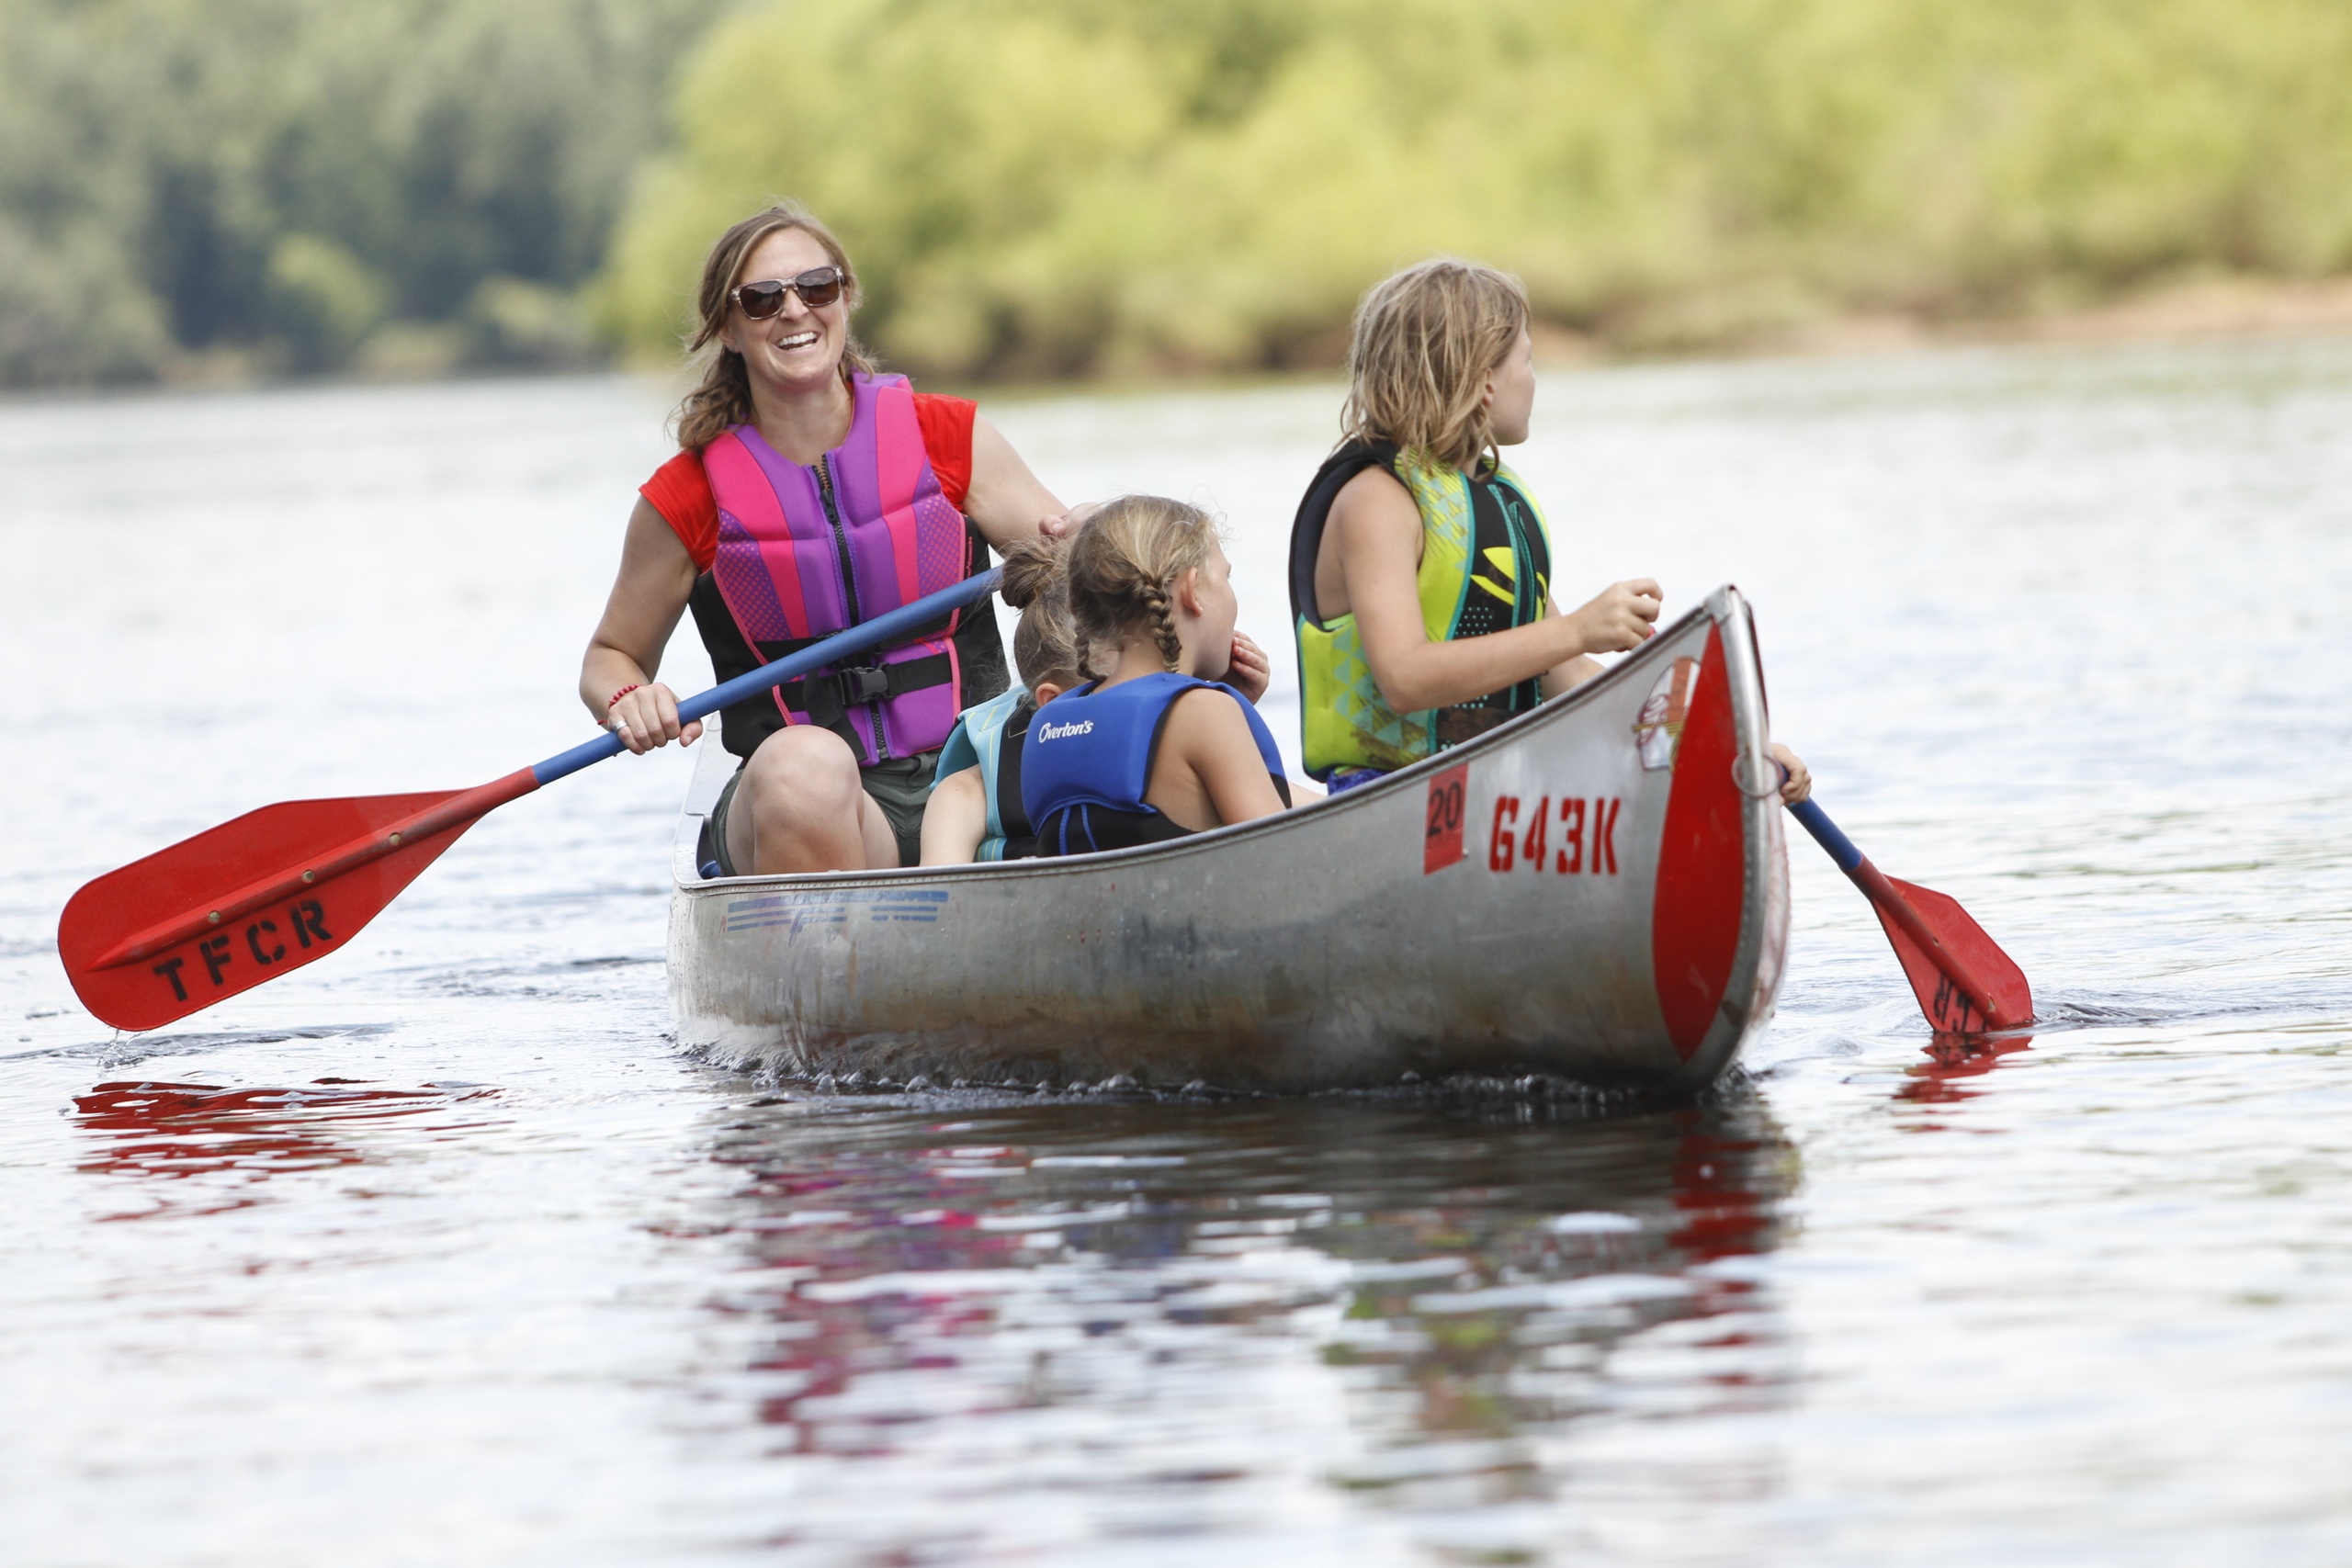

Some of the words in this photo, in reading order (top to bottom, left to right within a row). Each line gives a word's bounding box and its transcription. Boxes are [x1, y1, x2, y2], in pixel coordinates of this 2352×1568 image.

[1038, 720, 1093, 743] Overton's
[1427, 782, 1461, 838] 20
[1488, 795, 1621, 874] 643K
[153, 899, 333, 1002] TFCR
